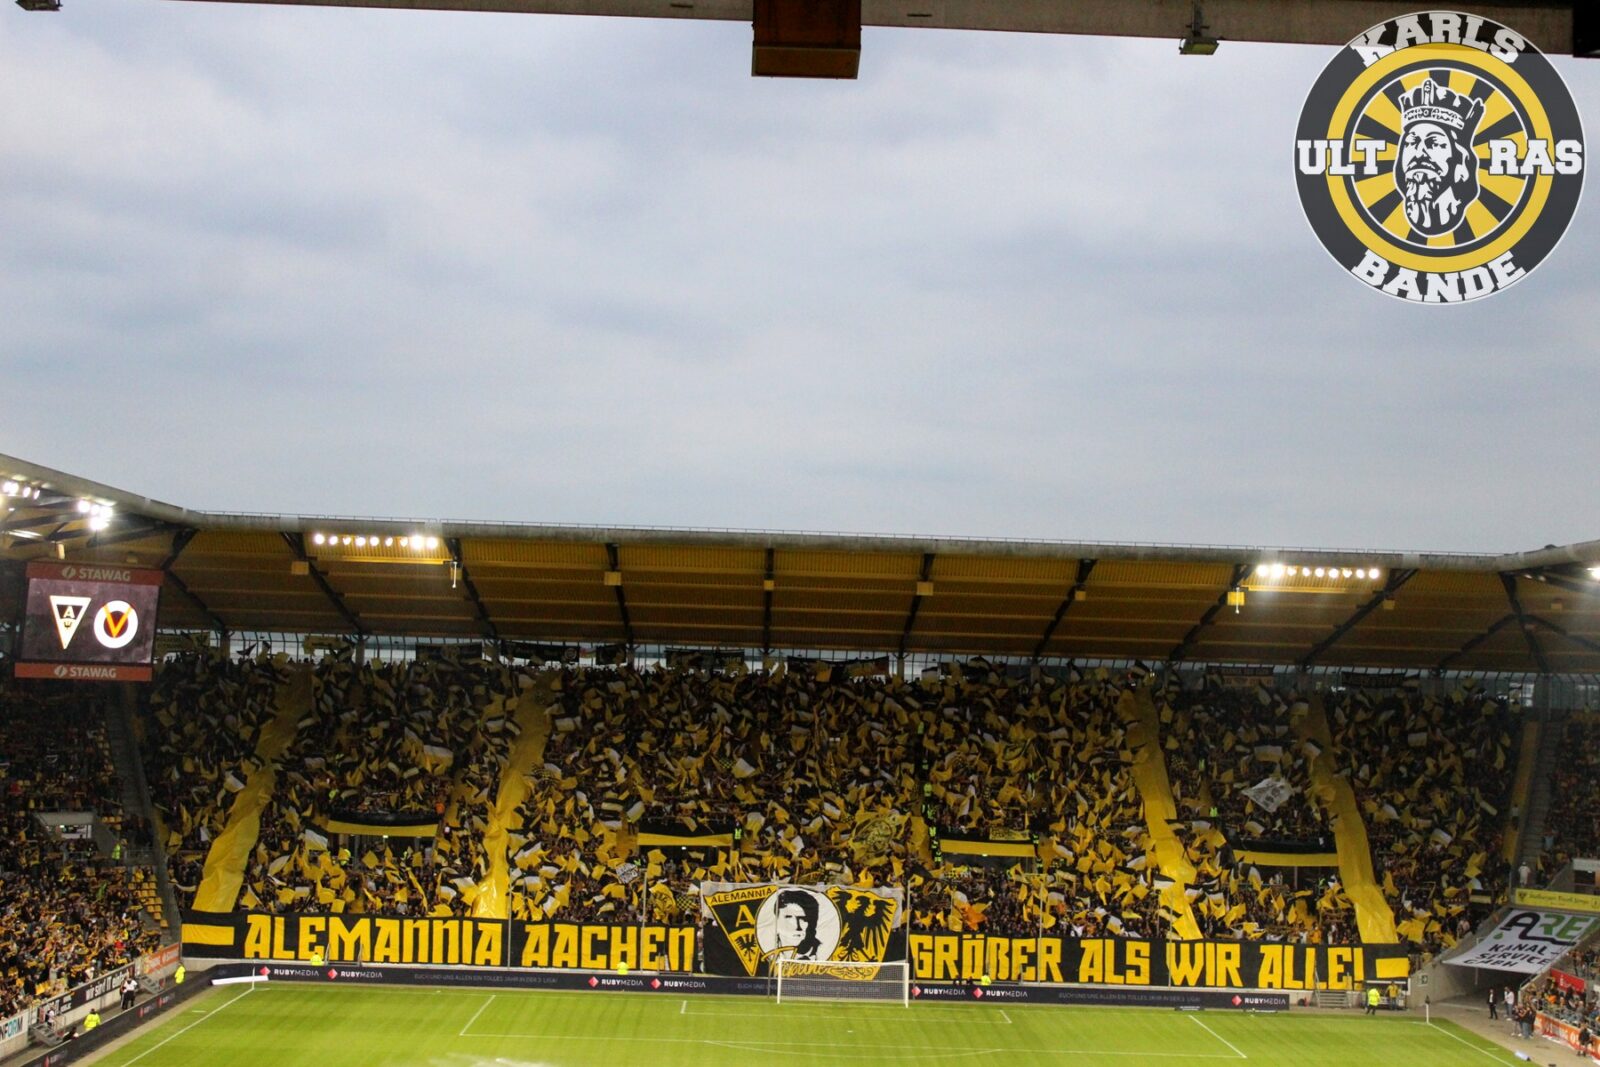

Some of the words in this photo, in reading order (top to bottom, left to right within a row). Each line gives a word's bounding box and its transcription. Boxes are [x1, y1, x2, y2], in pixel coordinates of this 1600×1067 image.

[78, 567, 131, 582] STAWAG
[69, 665, 117, 678] STAWAG
[711, 887, 772, 904] ALEMANNIA
[244, 914, 502, 966] ALEMANNIA
[521, 923, 695, 971] AACHEN
[1079, 939, 1150, 985] ALS
[1166, 942, 1244, 987] WIR
[1258, 945, 1365, 991] ALLE!
[1476, 952, 1551, 966] SERVICE
[273, 968, 320, 977] RUBYMEDIA
[340, 970, 383, 979] RUBYMEDIA
[601, 978, 643, 987] RUBYMEDIA
[663, 980, 706, 989] RUBYMEDIA
[923, 988, 966, 996] RUBYMEDIA
[986, 990, 1028, 998] RUBYMEDIA
[1244, 996, 1287, 1005] RUBYMEDIA
